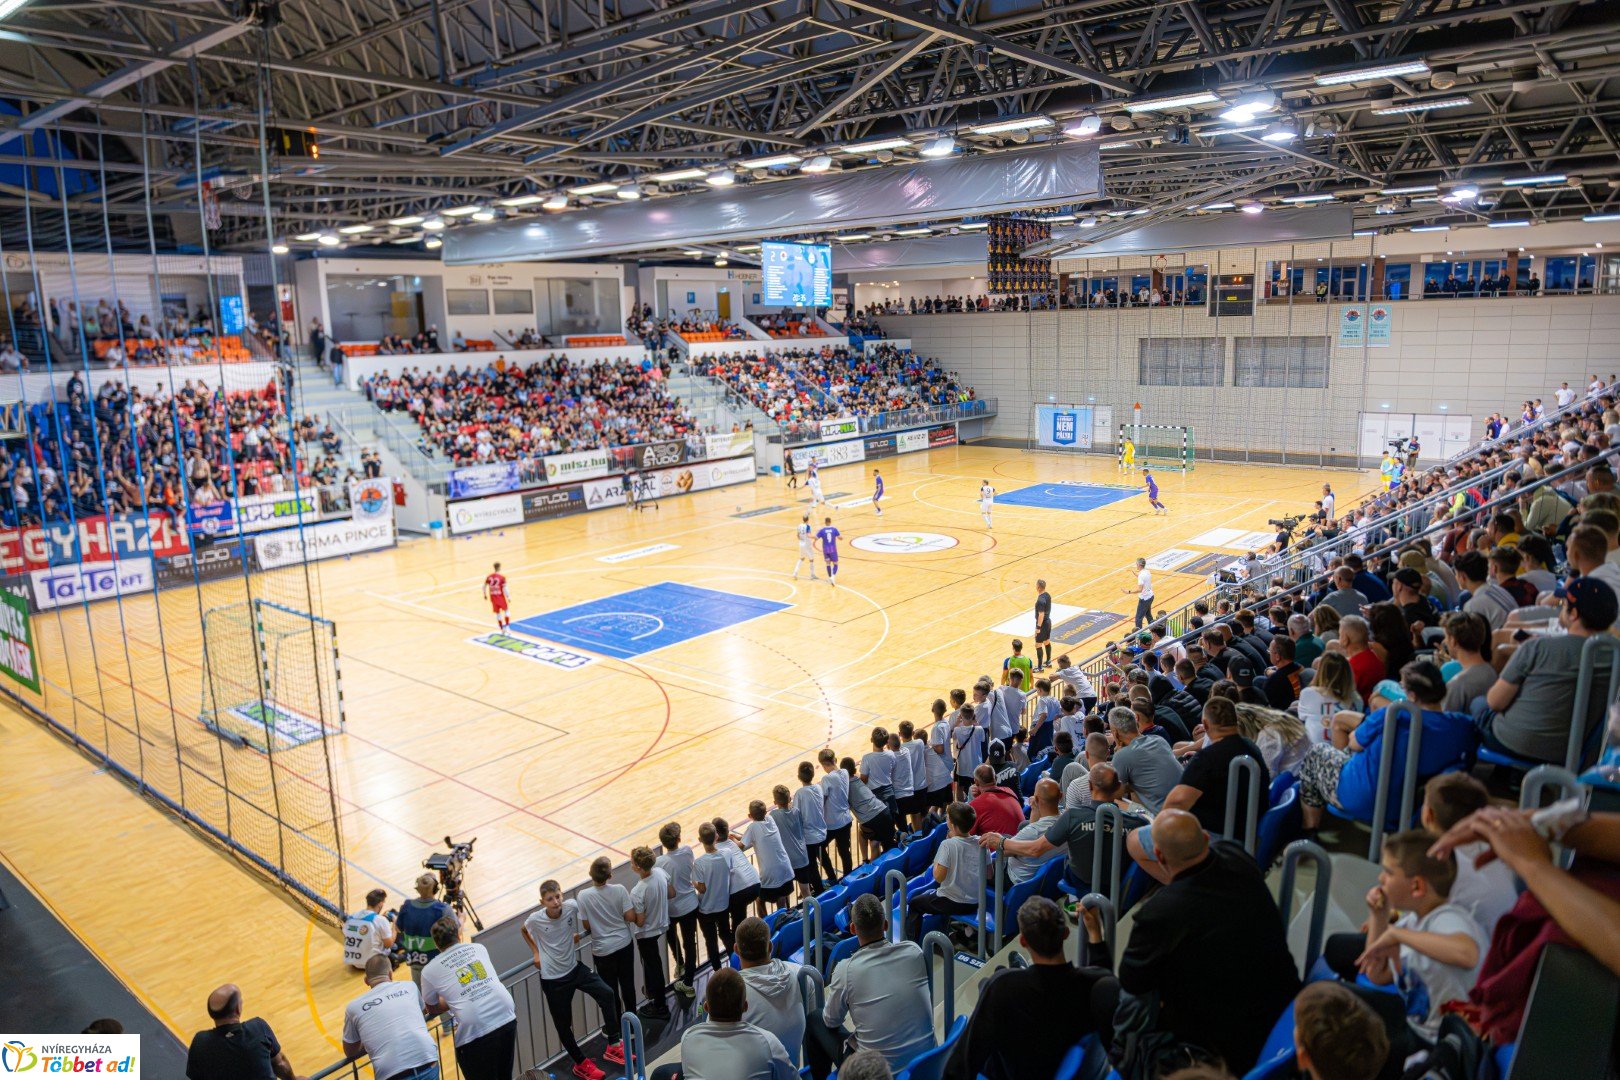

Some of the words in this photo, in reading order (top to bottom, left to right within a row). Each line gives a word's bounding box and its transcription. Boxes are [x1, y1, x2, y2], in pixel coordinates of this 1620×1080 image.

[1056, 421, 1074, 432] NEM
[643, 455, 679, 468] STUDIO
[605, 479, 656, 499] ARZNAL
[286, 533, 341, 552] TORMA
[345, 524, 388, 543] PINCE
[120, 574, 143, 587] KFT
[386, 989, 409, 1001] TISZA
